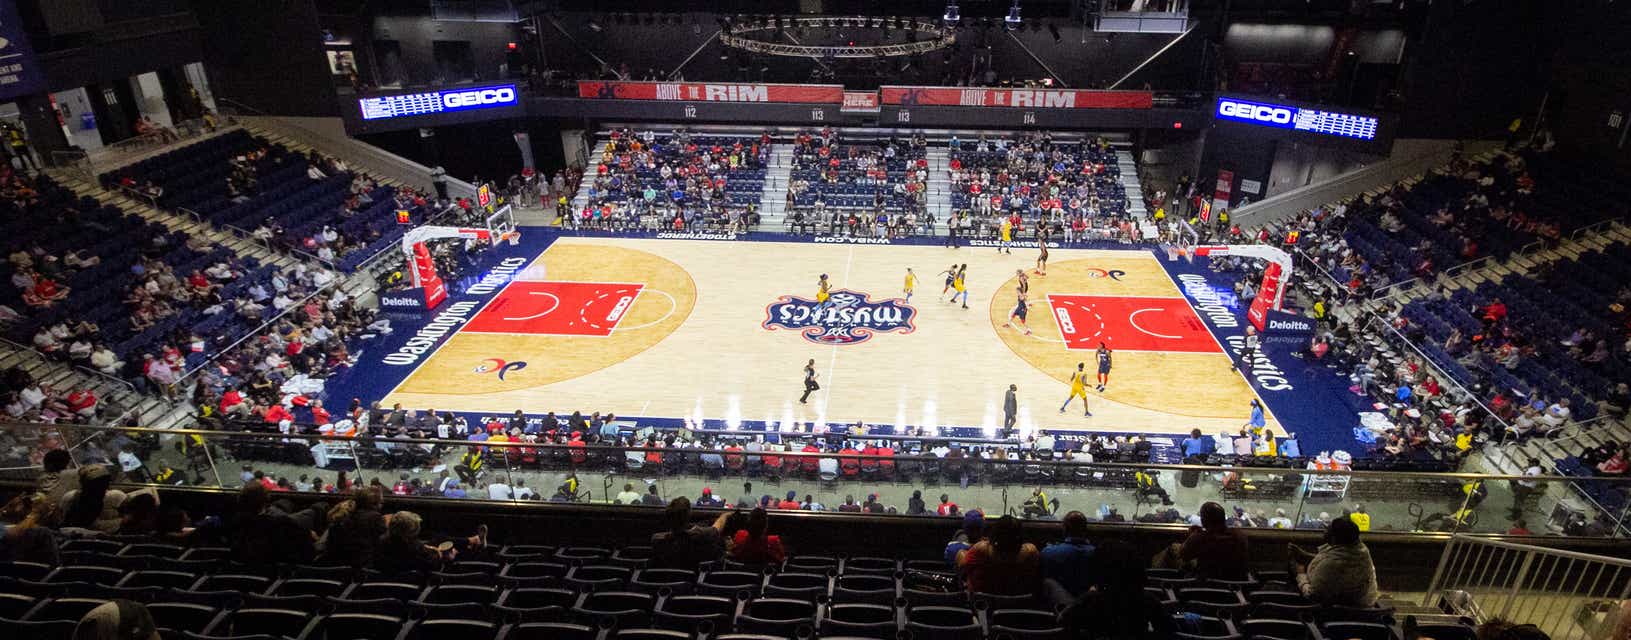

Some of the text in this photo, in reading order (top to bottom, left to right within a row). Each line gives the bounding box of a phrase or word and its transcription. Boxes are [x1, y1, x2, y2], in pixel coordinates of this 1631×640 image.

[443, 88, 515, 108] GEICO
[656, 84, 769, 101] ABOVE THE RIM
[960, 89, 1076, 107] ABOVE THE RIM
[685, 108, 696, 118] 112
[812, 111, 824, 120] 113
[898, 112, 910, 121] 113
[1024, 114, 1035, 125] 114
[1219, 101, 1291, 124] GEICO
[606, 296, 632, 321] GEICO
[1056, 307, 1076, 334] GEICO
[1270, 320, 1311, 330] Deloitte.
